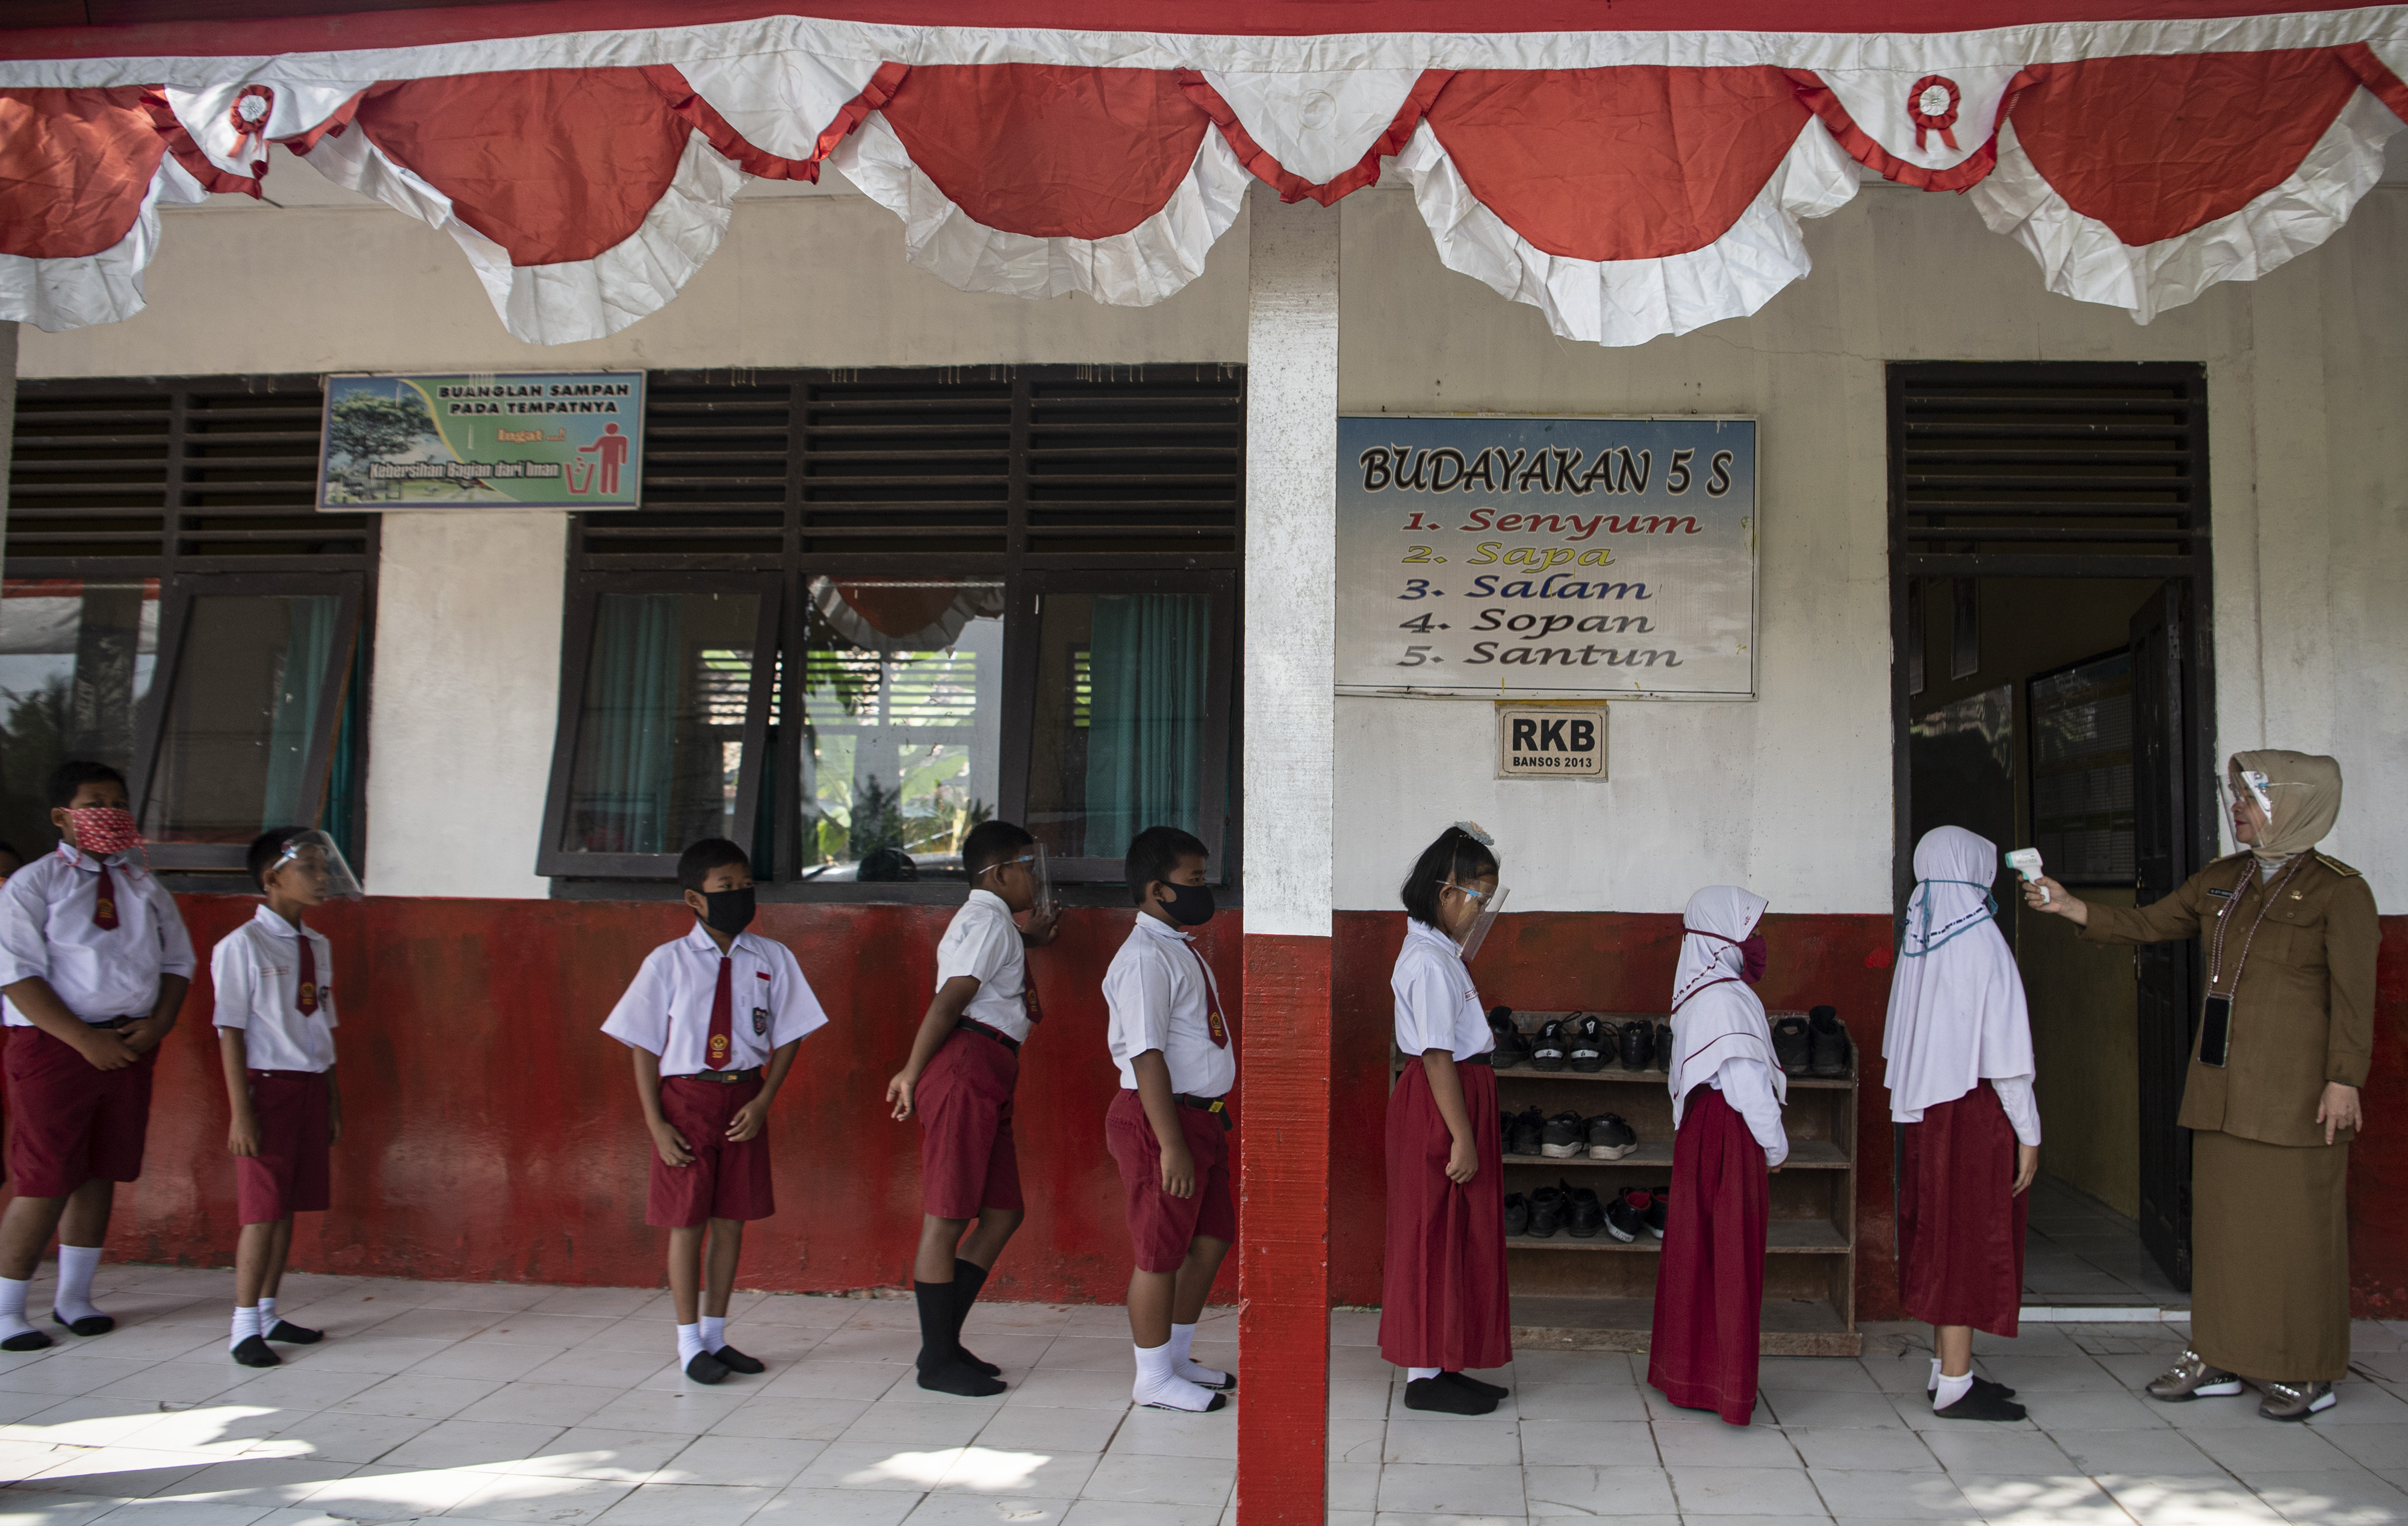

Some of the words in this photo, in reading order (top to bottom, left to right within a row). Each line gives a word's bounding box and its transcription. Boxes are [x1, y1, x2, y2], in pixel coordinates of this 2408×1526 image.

[437, 385, 543, 399] BUANGLAH
[548, 383, 630, 397] SAMPAH
[448, 402, 501, 415] PADA
[505, 400, 619, 415] TEMPATNYA
[497, 428, 544, 444] Ingat
[370, 461, 444, 479] Kebersihan
[446, 461, 492, 480] Bagian
[494, 461, 524, 478] dari
[524, 461, 560, 478] Iman
[1359, 442, 1651, 495] BUDAYAKAN
[1666, 448, 1695, 495] 5
[1705, 450, 1733, 497] S
[1401, 511, 1441, 531] 1.
[1459, 507, 1703, 541] Senyum
[1401, 545, 1448, 563] 2.
[1466, 541, 1616, 574] Sapa
[1396, 579, 1445, 600] 3.
[1463, 573, 1653, 600] Salam
[1398, 612, 1452, 634] 4.
[1469, 608, 1655, 640] Sopan
[1395, 645, 1445, 667] 5.
[1462, 640, 1683, 668] Santun
[1512, 718, 1595, 752] RKB
[1513, 756, 1560, 768] BANSOS
[1565, 757, 1592, 768] 2013
